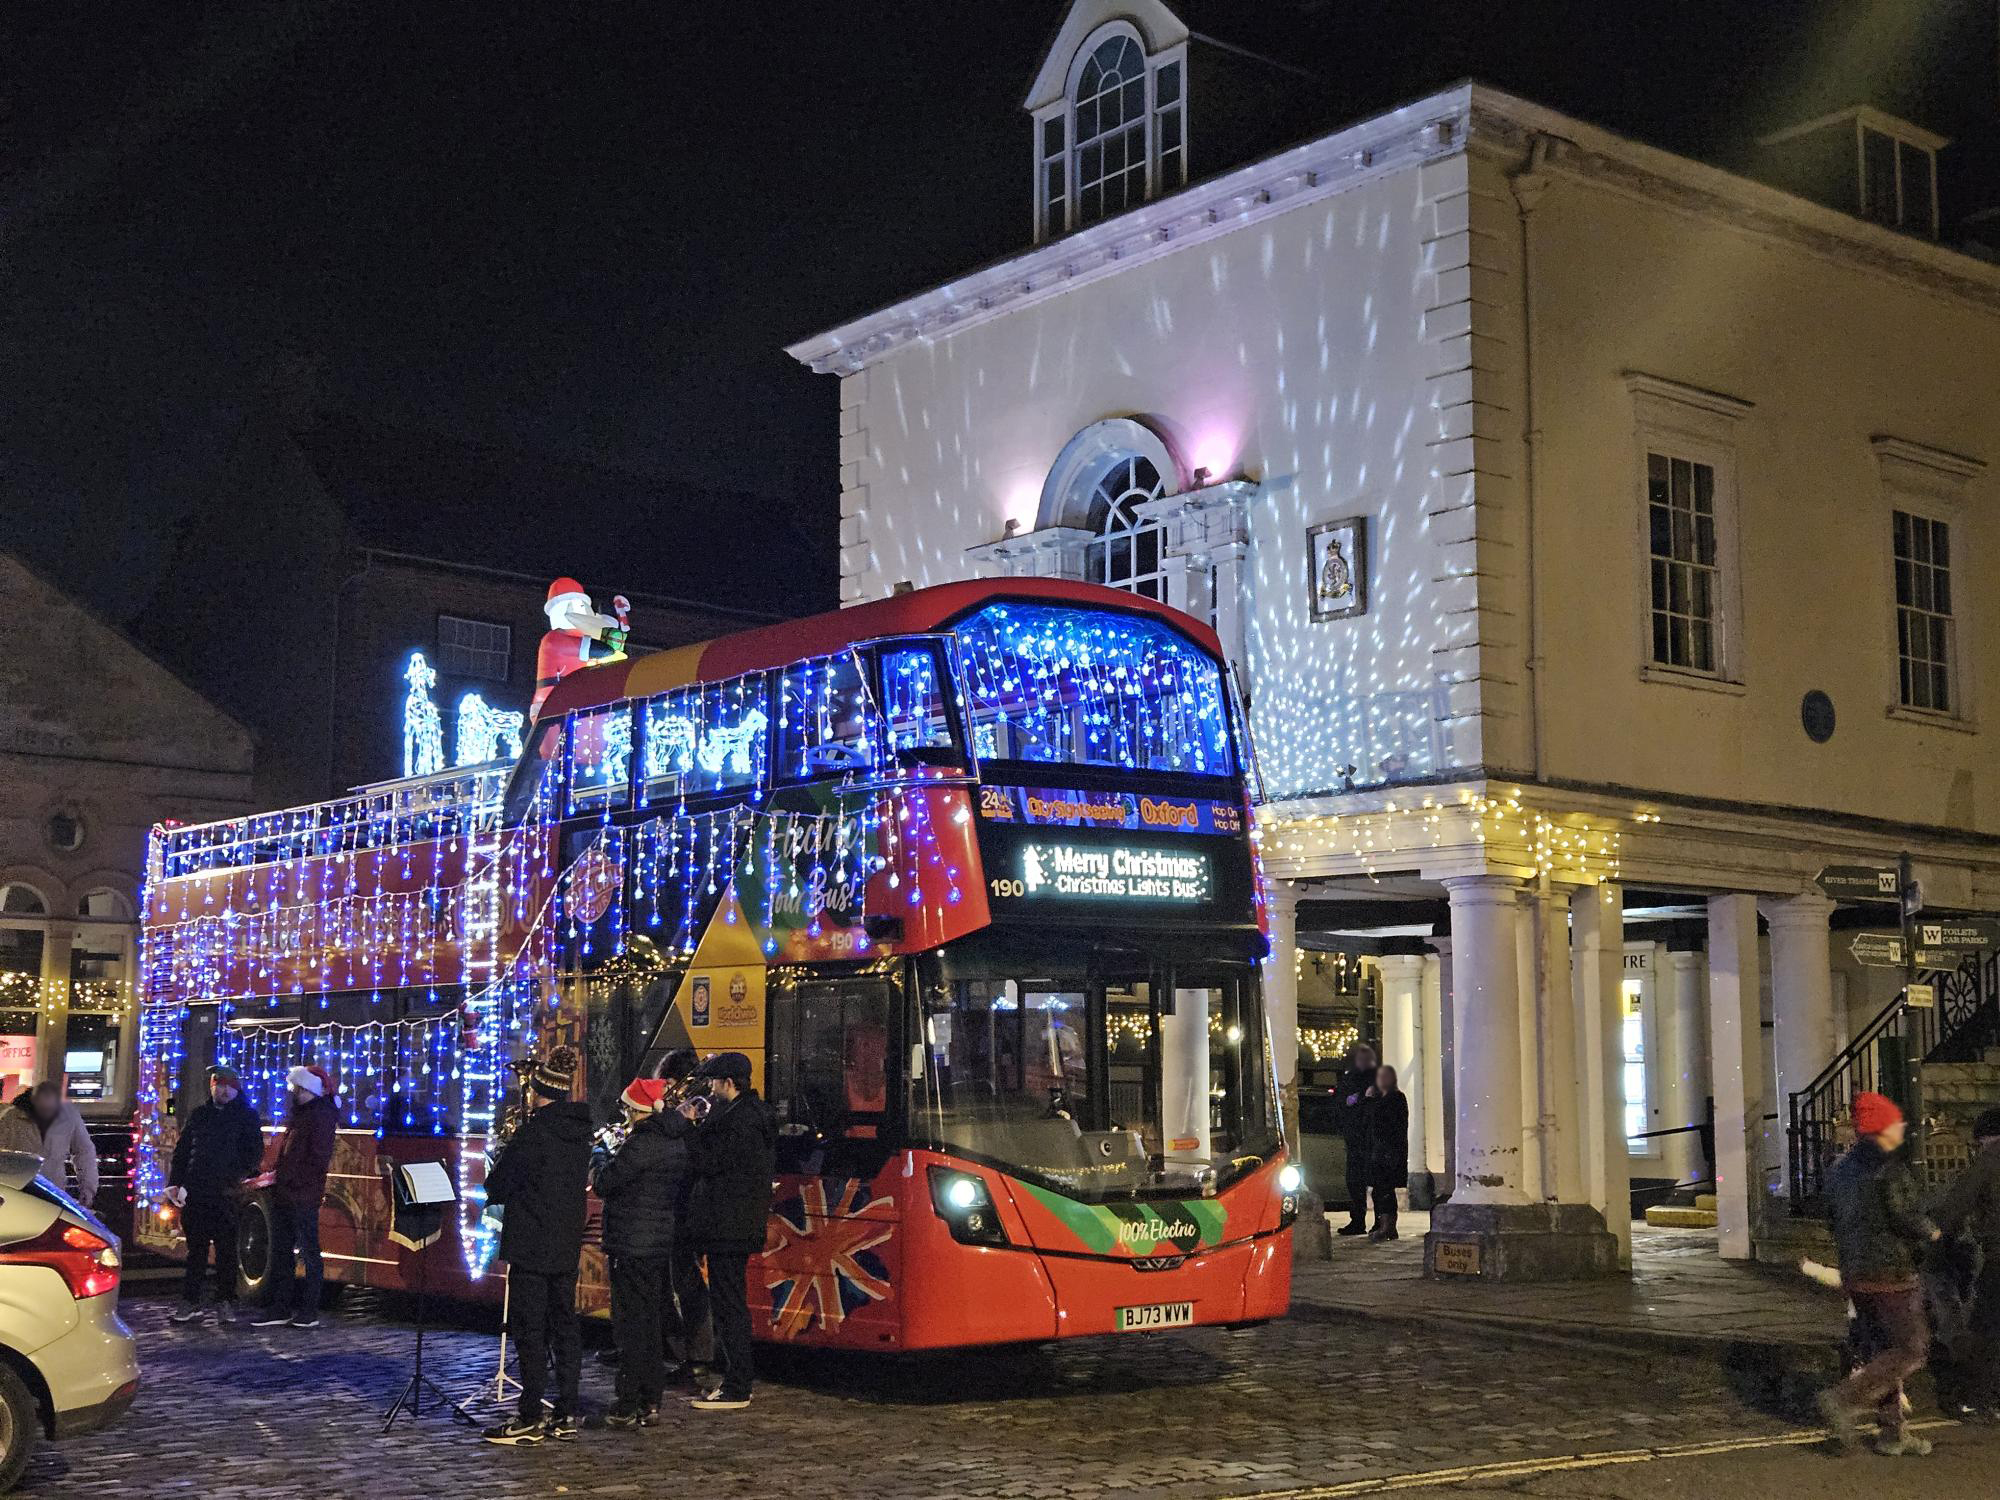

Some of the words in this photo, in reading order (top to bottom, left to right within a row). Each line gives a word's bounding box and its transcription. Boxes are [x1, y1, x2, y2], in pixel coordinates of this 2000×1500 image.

[1141, 798, 1199, 826] Oxford
[1212, 806, 1227, 817] Hop
[1227, 807, 1238, 817] On
[1214, 819, 1228, 830] Hop
[1229, 820, 1240, 831] Off
[1054, 847, 1110, 878] Merry
[1113, 849, 1199, 878] Christmas
[806, 866, 858, 917] Bus!
[990, 880, 1024, 897] 190
[1057, 874, 1126, 895] Christmas
[1128, 877, 1170, 896] Lights
[1172, 879, 1197, 898] Bus
[1942, 928, 1978, 936] TOILETS
[1942, 936, 1960, 944] CAR
[1961, 937, 1989, 945] PARKS
[831, 932, 853, 950] 190
[3, 1046, 32, 1058] OFFICE
[1119, 1221, 1150, 1243] 100%
[1150, 1219, 1197, 1241] Electric
[1443, 1244, 1473, 1258] Buses
[1126, 1306, 1161, 1327] BJ73
[1164, 1303, 1190, 1323] WVW
